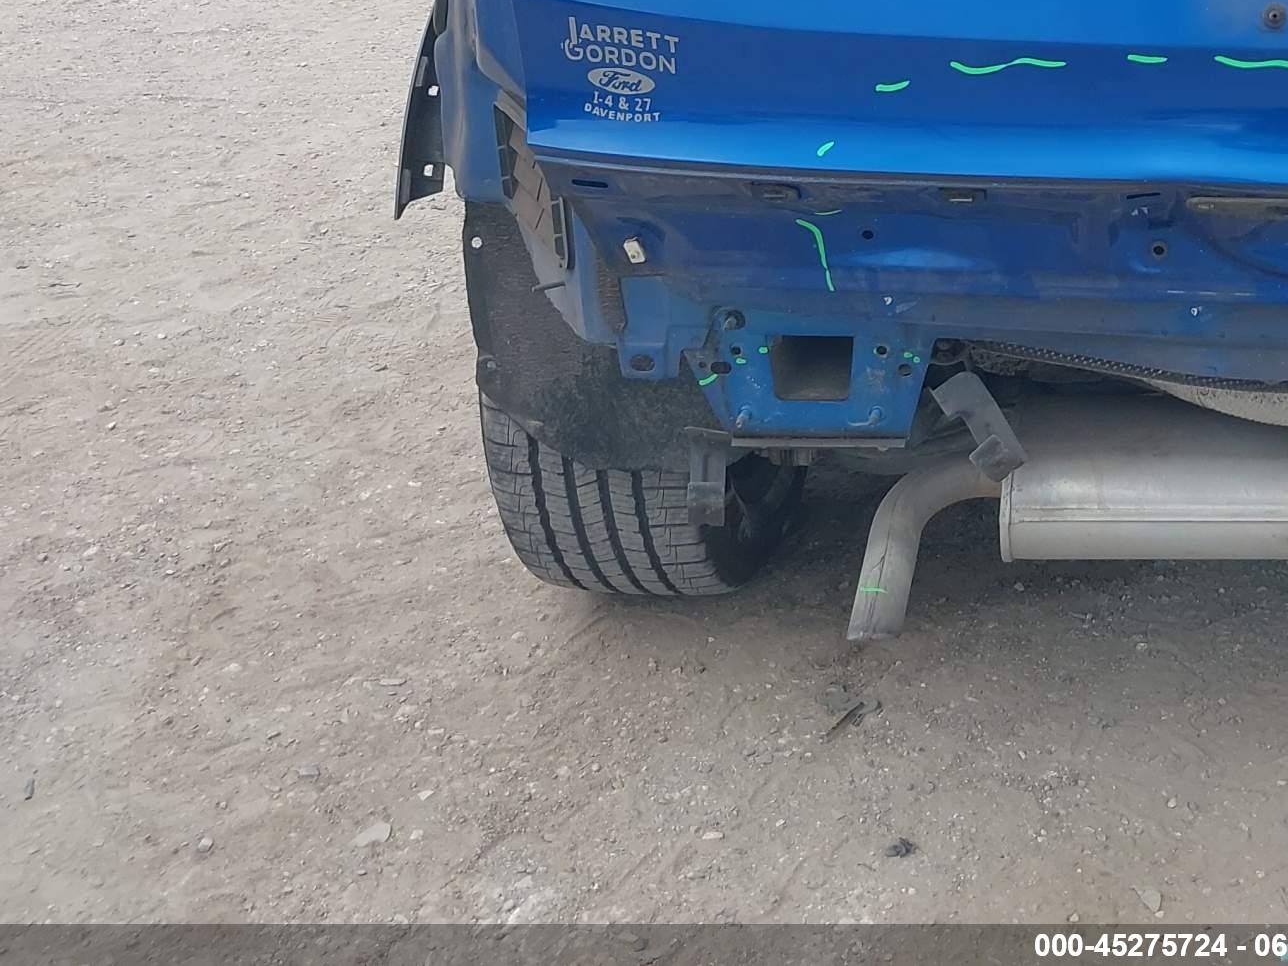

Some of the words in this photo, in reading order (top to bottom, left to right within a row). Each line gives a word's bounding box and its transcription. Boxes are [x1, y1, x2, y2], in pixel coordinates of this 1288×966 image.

[568, 16, 680, 53] JARRETT
[564, 38, 676, 74] GORDON
[599, 70, 642, 92] Ford
[584, 102, 661, 123] DAVENPORT
[593, 91, 613, 108] I-4
[618, 96, 630, 111] &
[634, 98, 652, 112] 27
